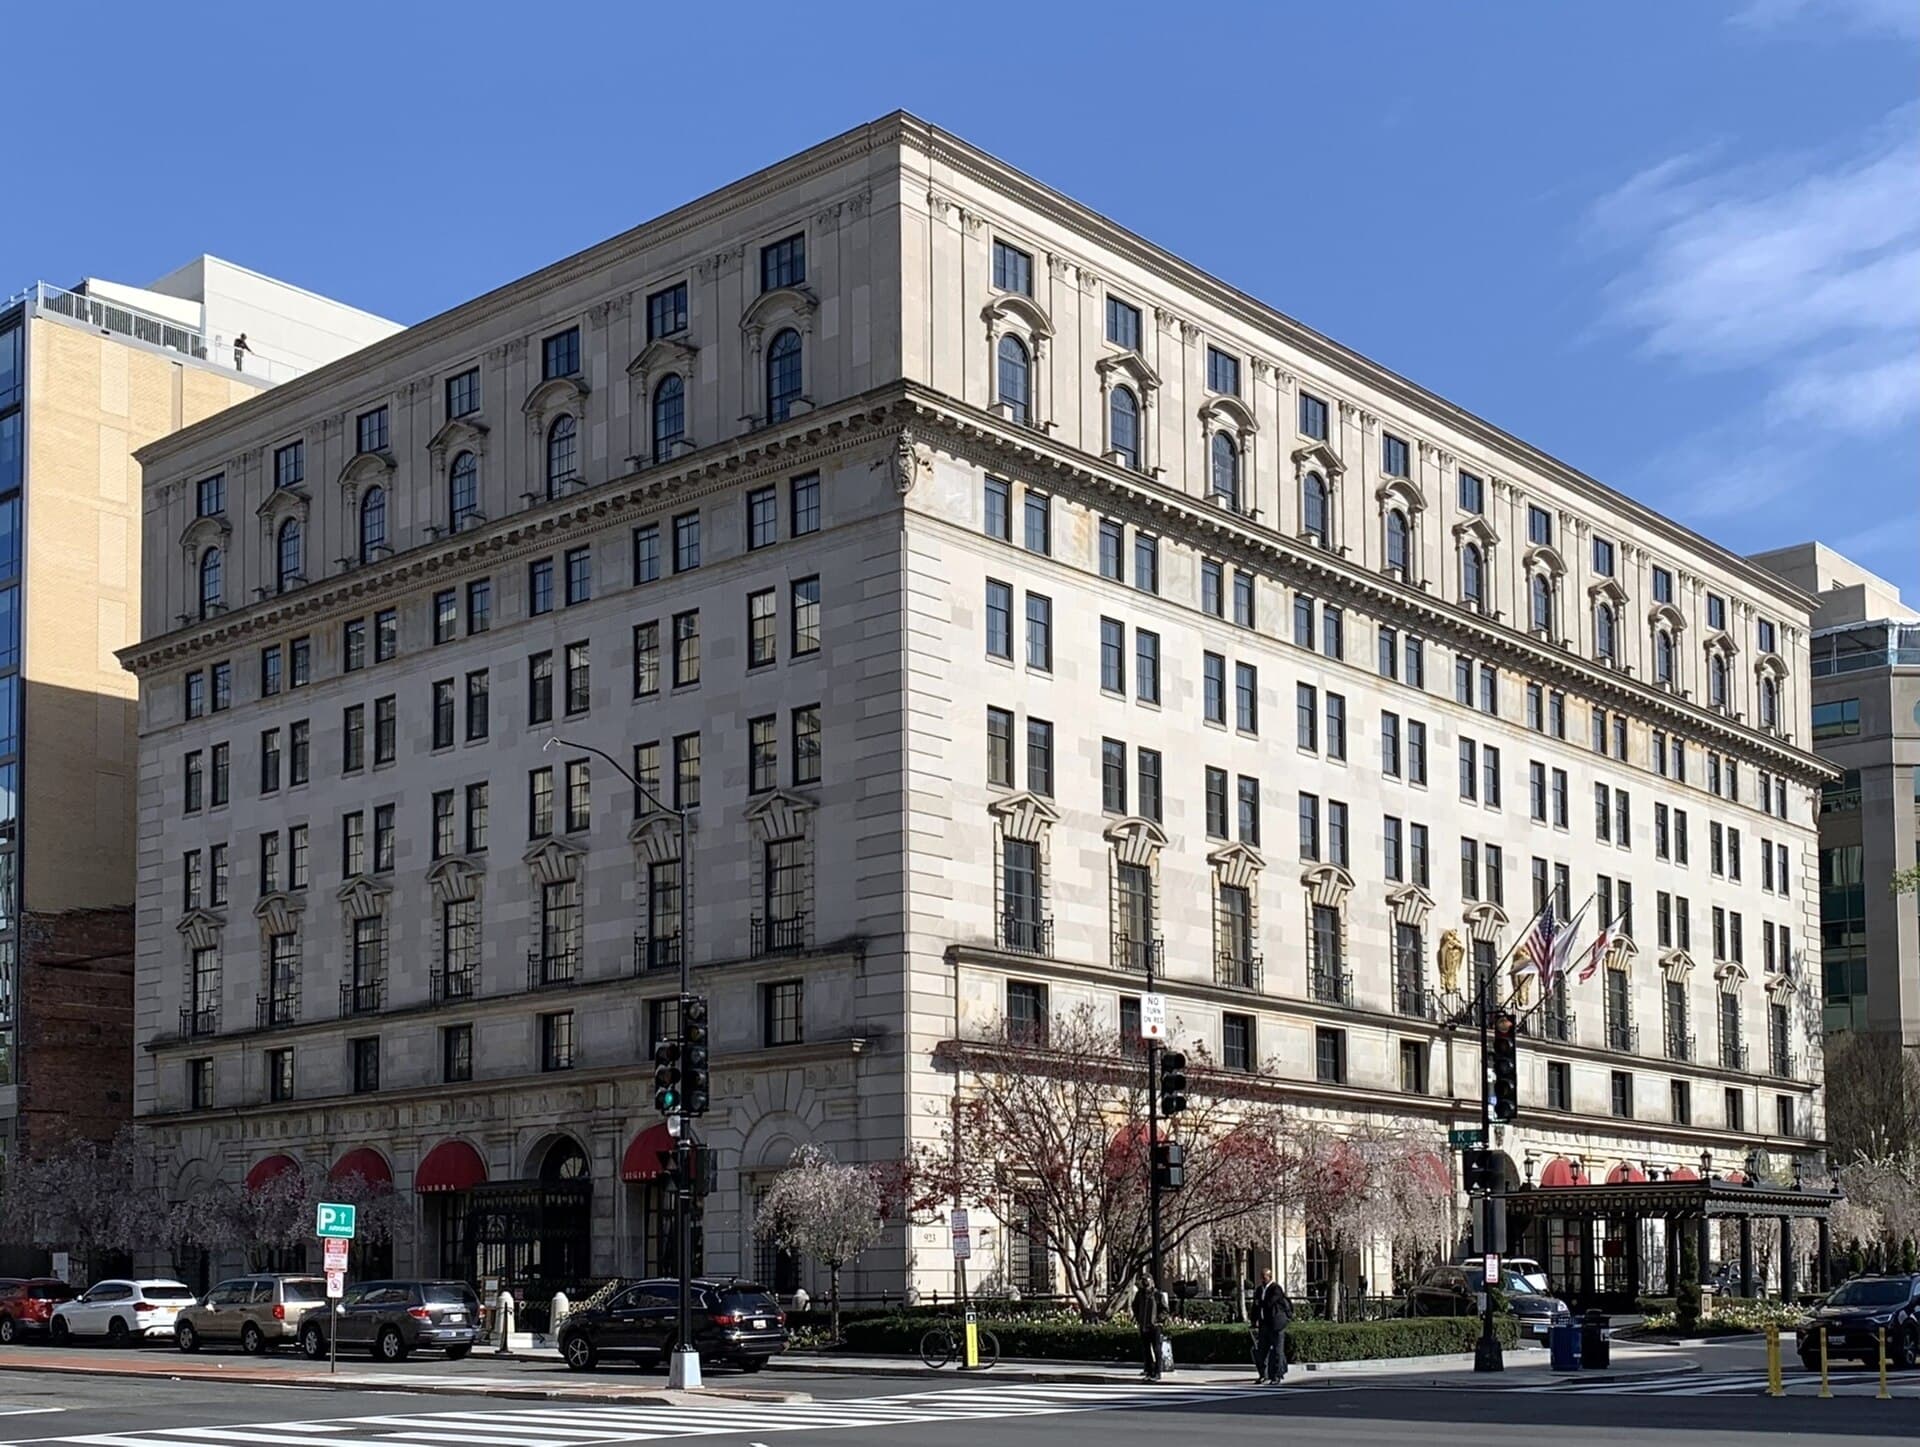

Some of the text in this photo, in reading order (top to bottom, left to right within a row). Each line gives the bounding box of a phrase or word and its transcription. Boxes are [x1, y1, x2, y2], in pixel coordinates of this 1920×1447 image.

[1147, 997, 1158, 1006] NO
[1146, 1007, 1161, 1015] TURN
[1153, 1016, 1164, 1024] RED
[1457, 1131, 1464, 1142] K
